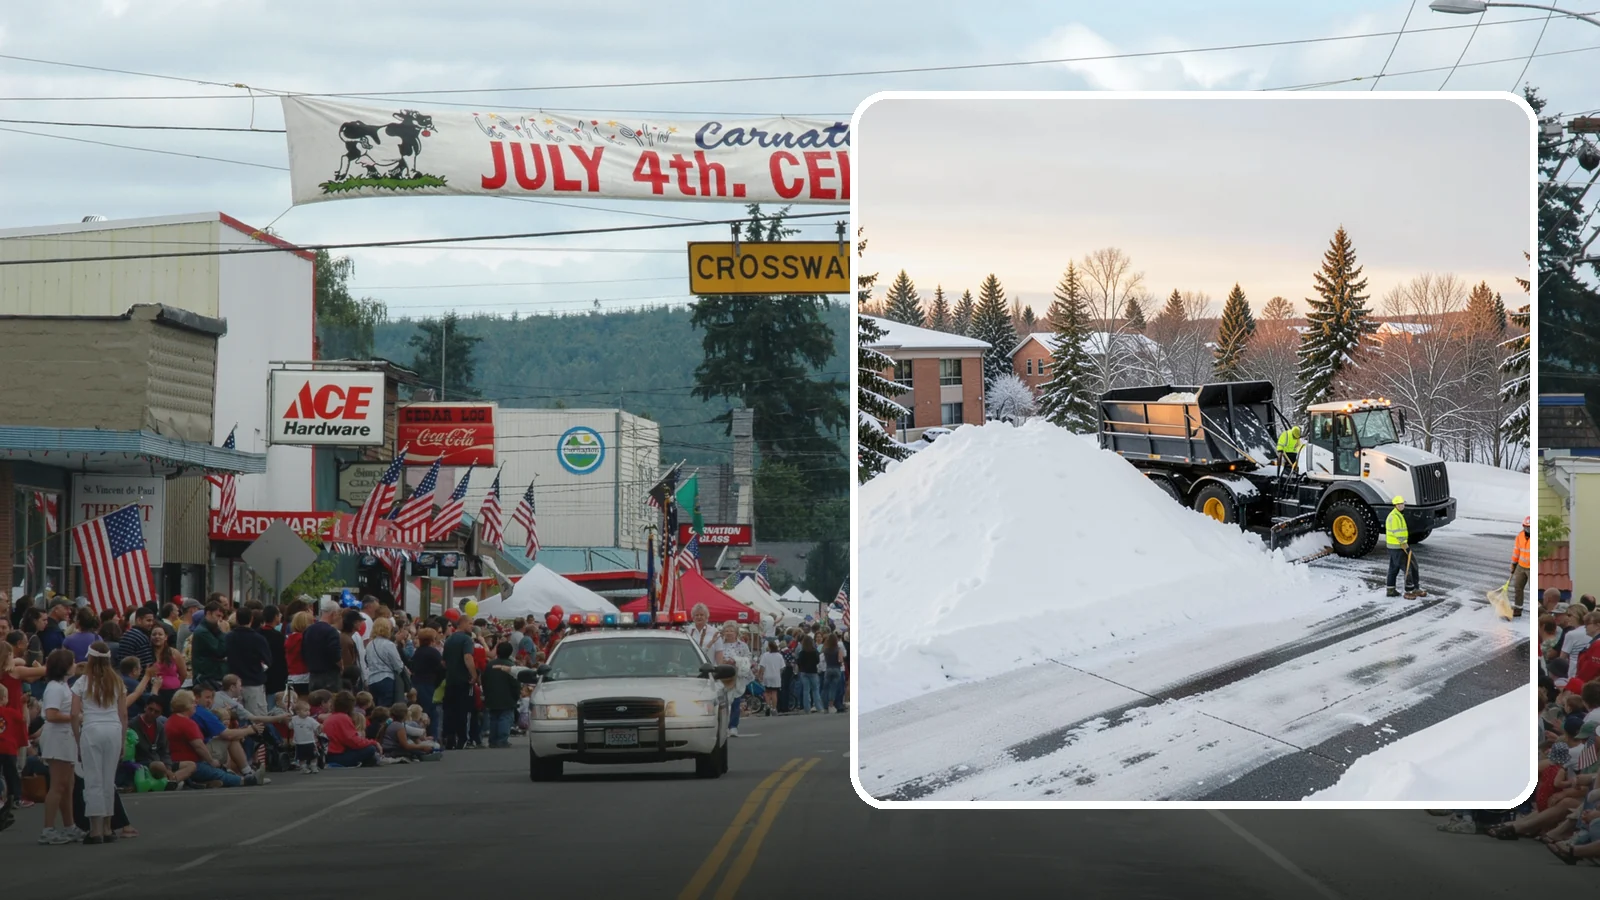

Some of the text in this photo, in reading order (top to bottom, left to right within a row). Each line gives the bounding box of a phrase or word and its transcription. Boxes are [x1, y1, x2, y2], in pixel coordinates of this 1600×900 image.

[695, 121, 850, 150] Carnat
[481, 141, 605, 192] JULY
[632, 150, 746, 198] 4th.
[697, 254, 850, 280] CROSSWA
[283, 380, 373, 420] ACE
[406, 409, 485, 422] CEDAR LOG
[283, 421, 371, 436] Hardware
[83, 484, 155, 496] St. Vincent de Paul
[688, 526, 741, 535] CRNATION
[699, 535, 730, 543] GLASS
